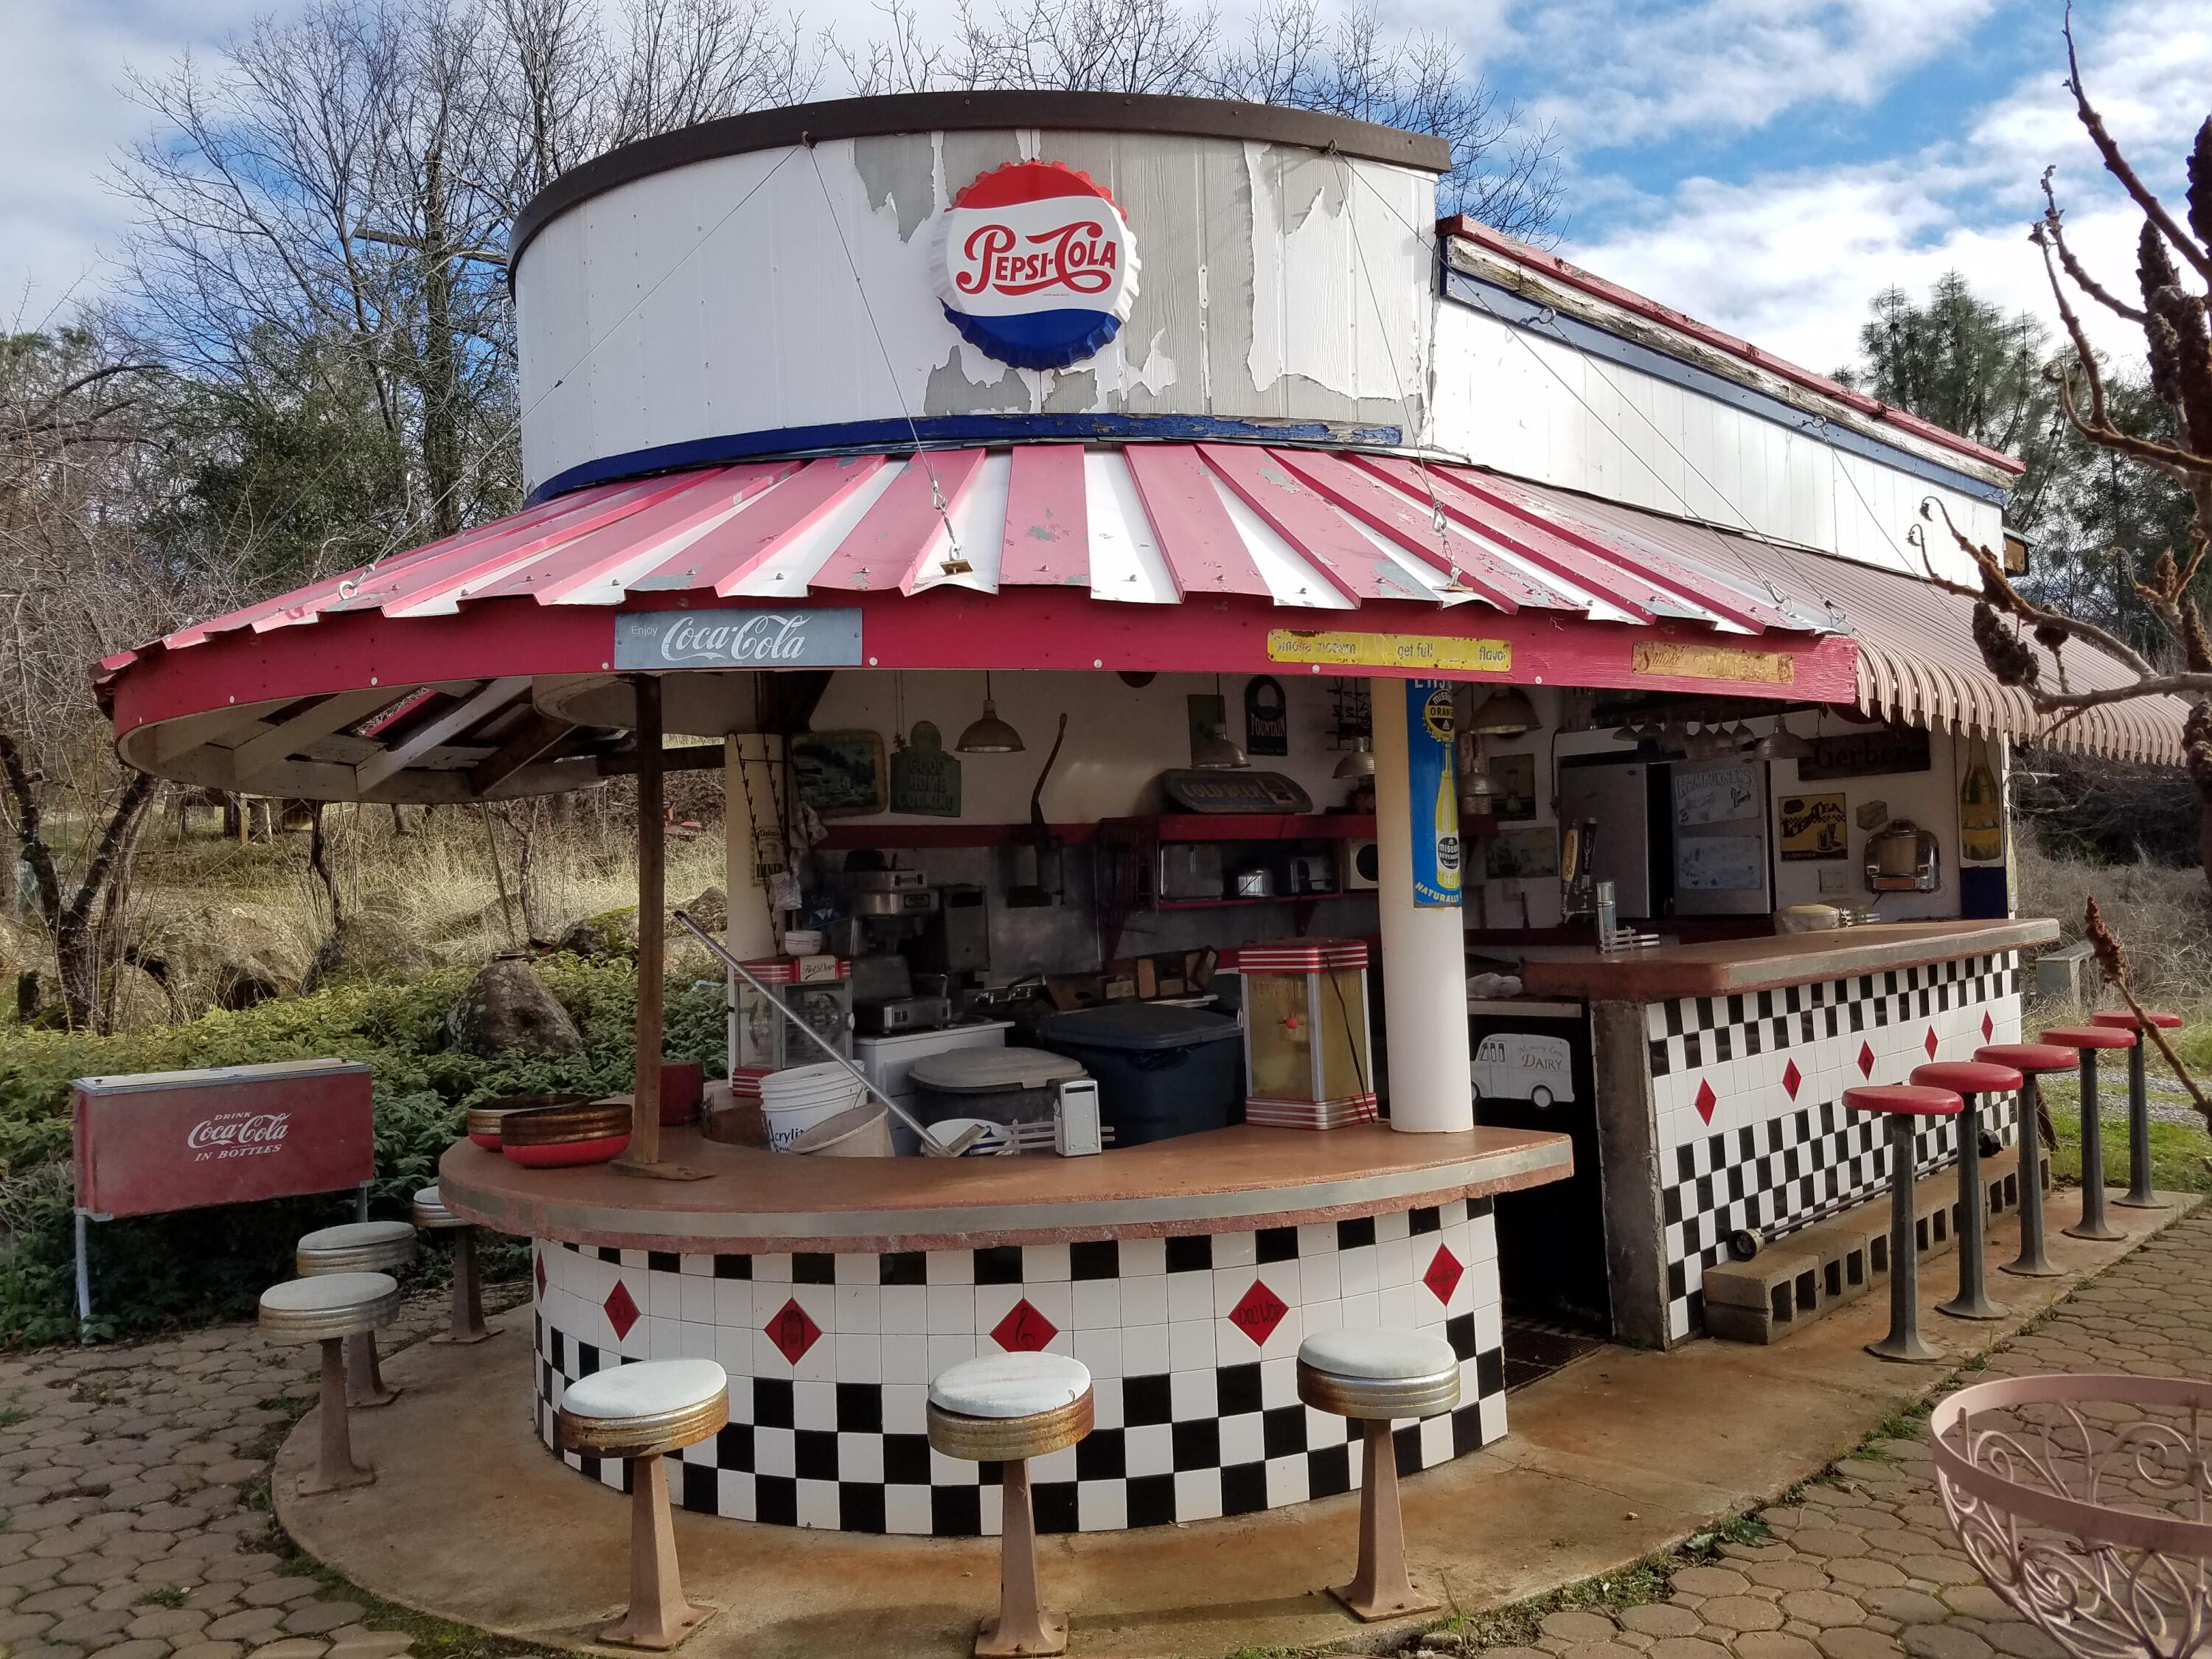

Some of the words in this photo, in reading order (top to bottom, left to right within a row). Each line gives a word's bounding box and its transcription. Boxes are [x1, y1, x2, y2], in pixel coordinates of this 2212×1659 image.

[631, 625, 658, 636] Enjoy
[661, 613, 814, 661] Coca-Cola
[1397, 644, 1414, 660] get
[1251, 712, 1285, 737] FOUNTAIN
[909, 757, 945, 774] GOOD
[909, 775, 947, 793] HOME
[1180, 784, 1224, 798] COLD
[897, 790, 955, 810] COOKING
[1811, 801, 1844, 821] TEA
[1521, 1053, 1562, 1069] DAIRY
[214, 1111, 251, 1121] DRINK
[187, 1112, 292, 1149] Coca-Cola
[194, 1152, 213, 1162] IN
[217, 1144, 282, 1159] BOTTLES
